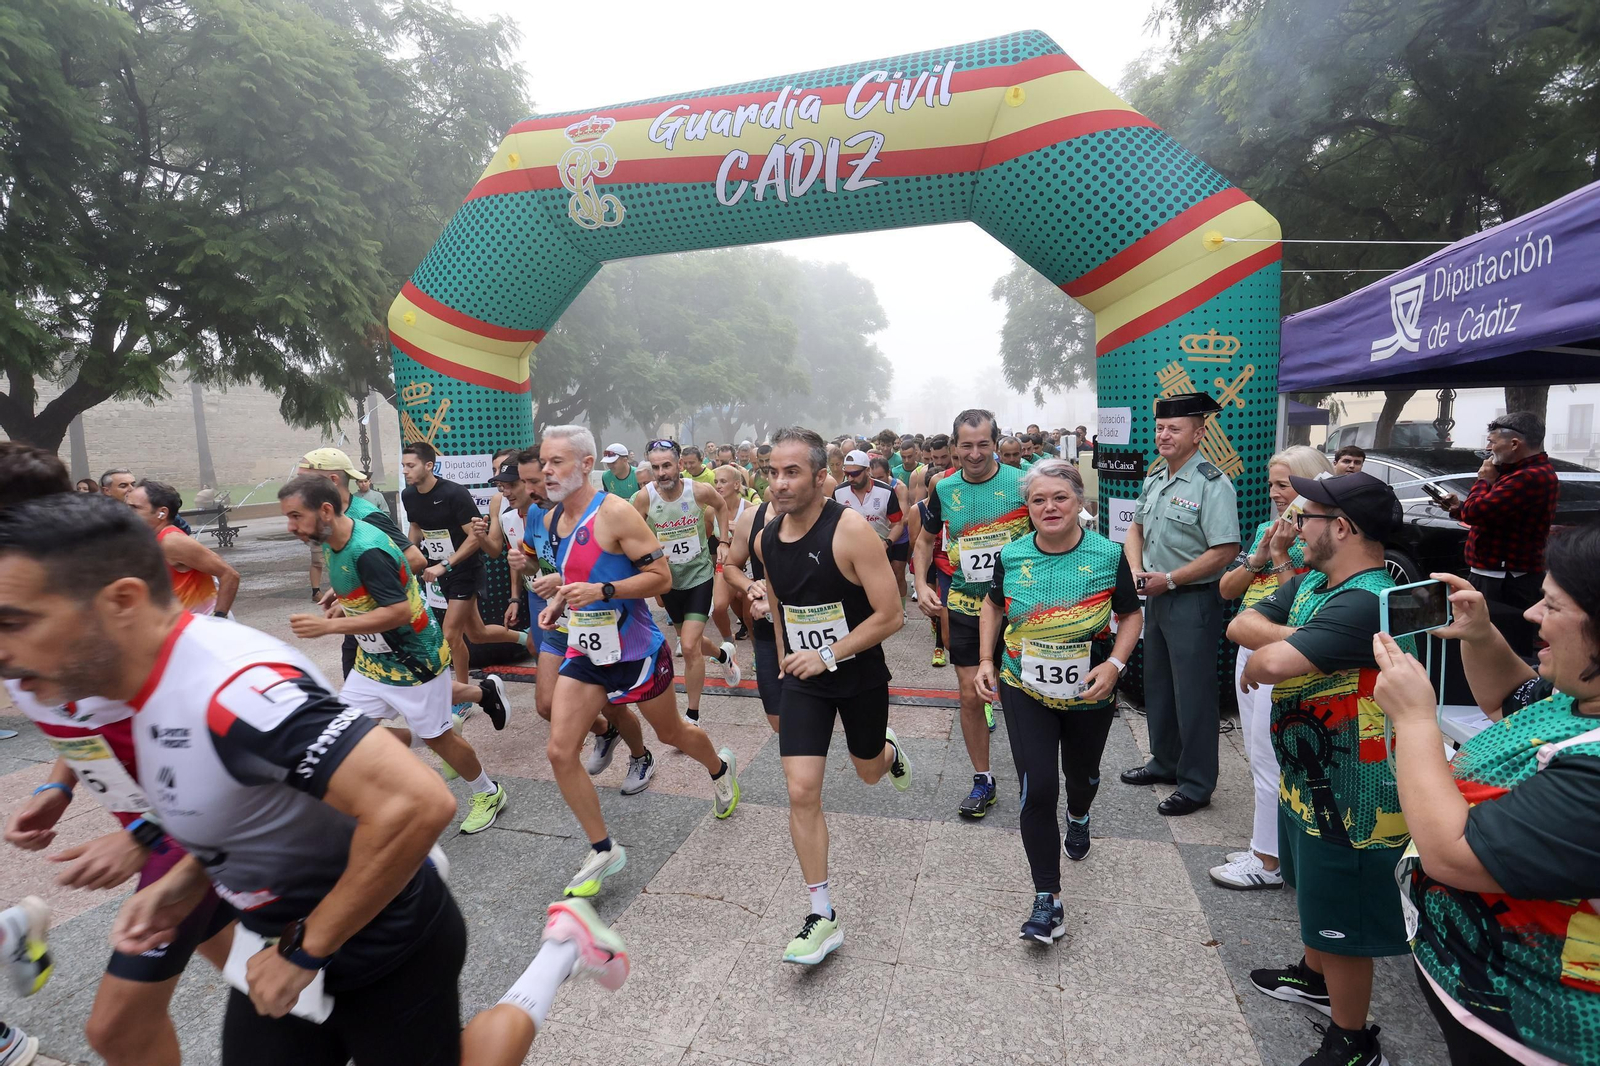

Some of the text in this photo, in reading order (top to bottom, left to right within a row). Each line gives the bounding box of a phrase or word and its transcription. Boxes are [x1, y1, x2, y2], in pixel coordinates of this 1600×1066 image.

[648, 60, 956, 150] Guardia Civil
[715, 131, 886, 207] CÁDIZ
[1433, 231, 1553, 302] Diputación
[1427, 297, 1522, 350] de Cádiz
[445, 460, 487, 469] Diputación
[446, 470, 480, 479] de Cádiz
[654, 514, 699, 529] maratón
[429, 542, 444, 553] 35
[672, 541, 690, 555] 45
[578, 632, 602, 651] 68
[797, 627, 838, 650] 105
[1034, 664, 1079, 684] 136
